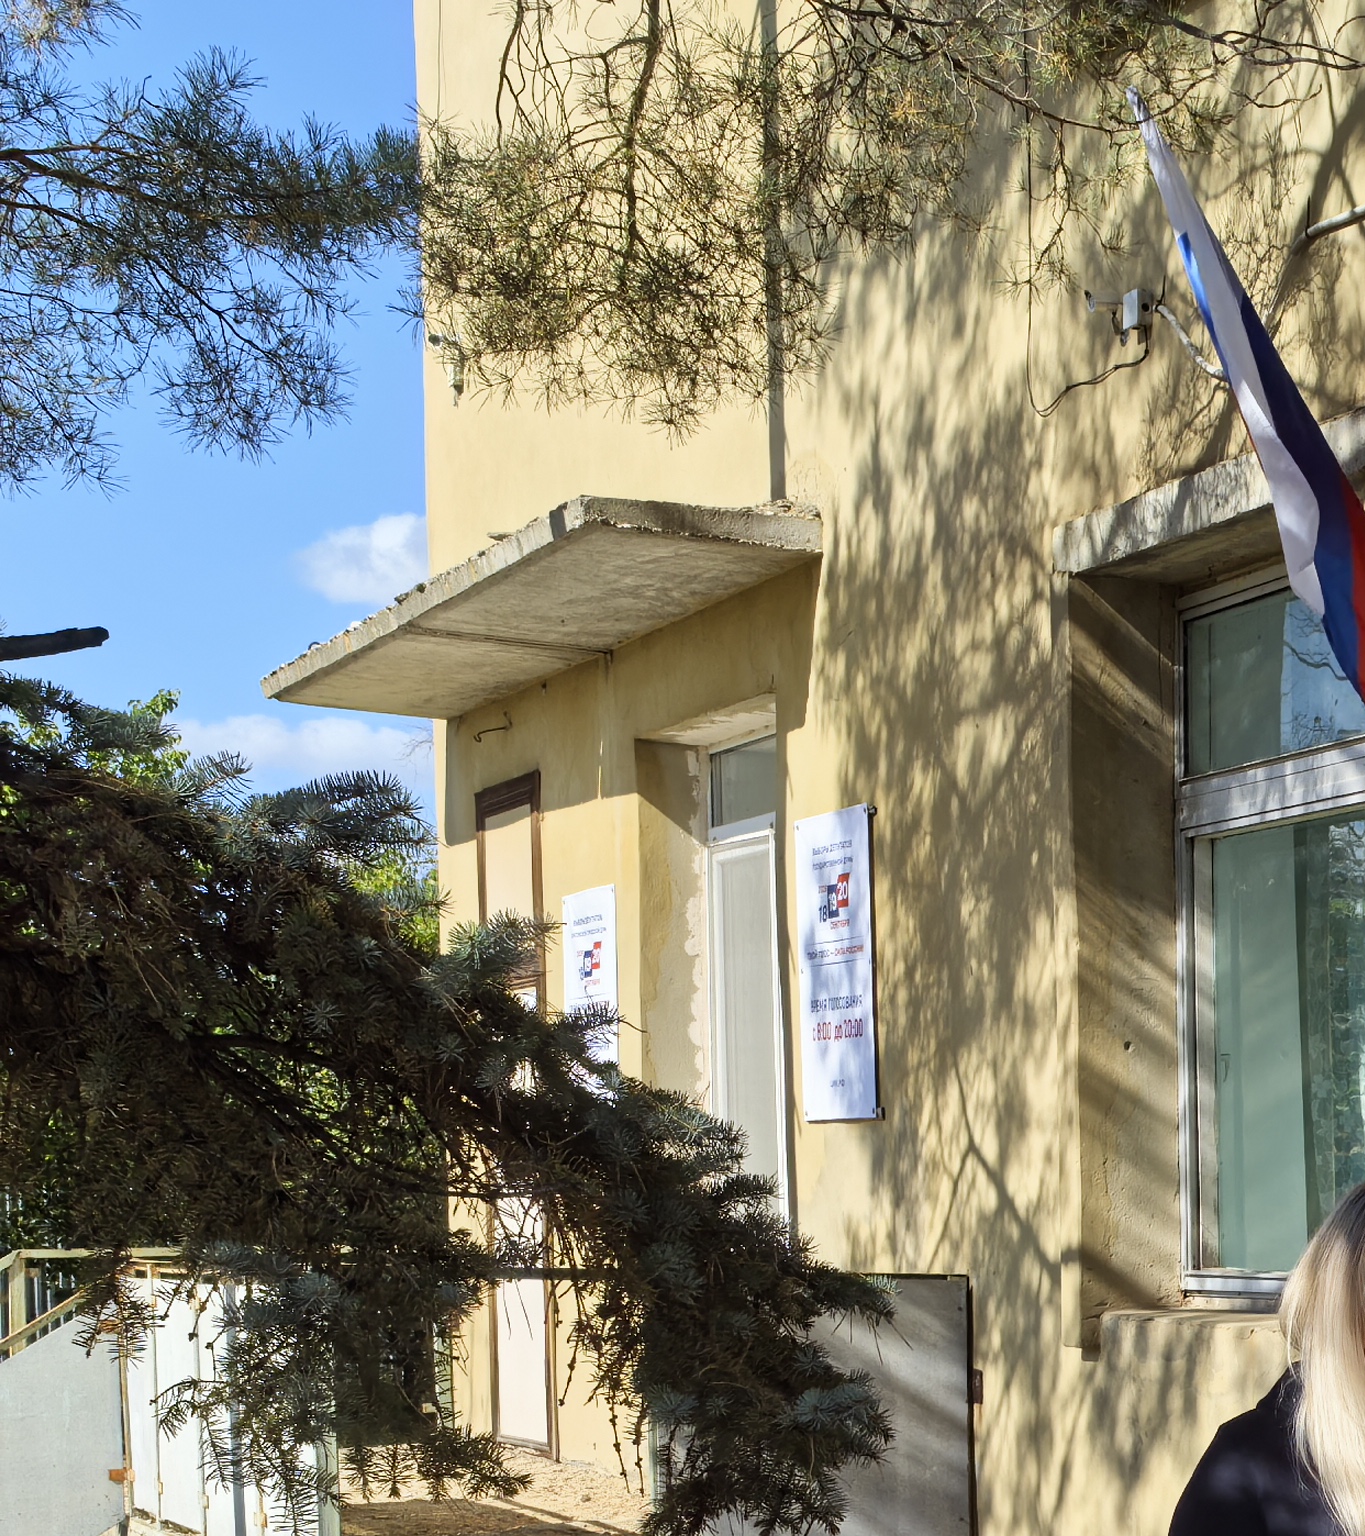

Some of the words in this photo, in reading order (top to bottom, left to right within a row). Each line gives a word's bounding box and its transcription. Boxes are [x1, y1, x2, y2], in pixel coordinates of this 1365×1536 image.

[836, 881, 848, 900] 20
[828, 892, 837, 912] 19
[818, 905, 828, 922] 18
[844, 1019, 863, 1038] 20:00
